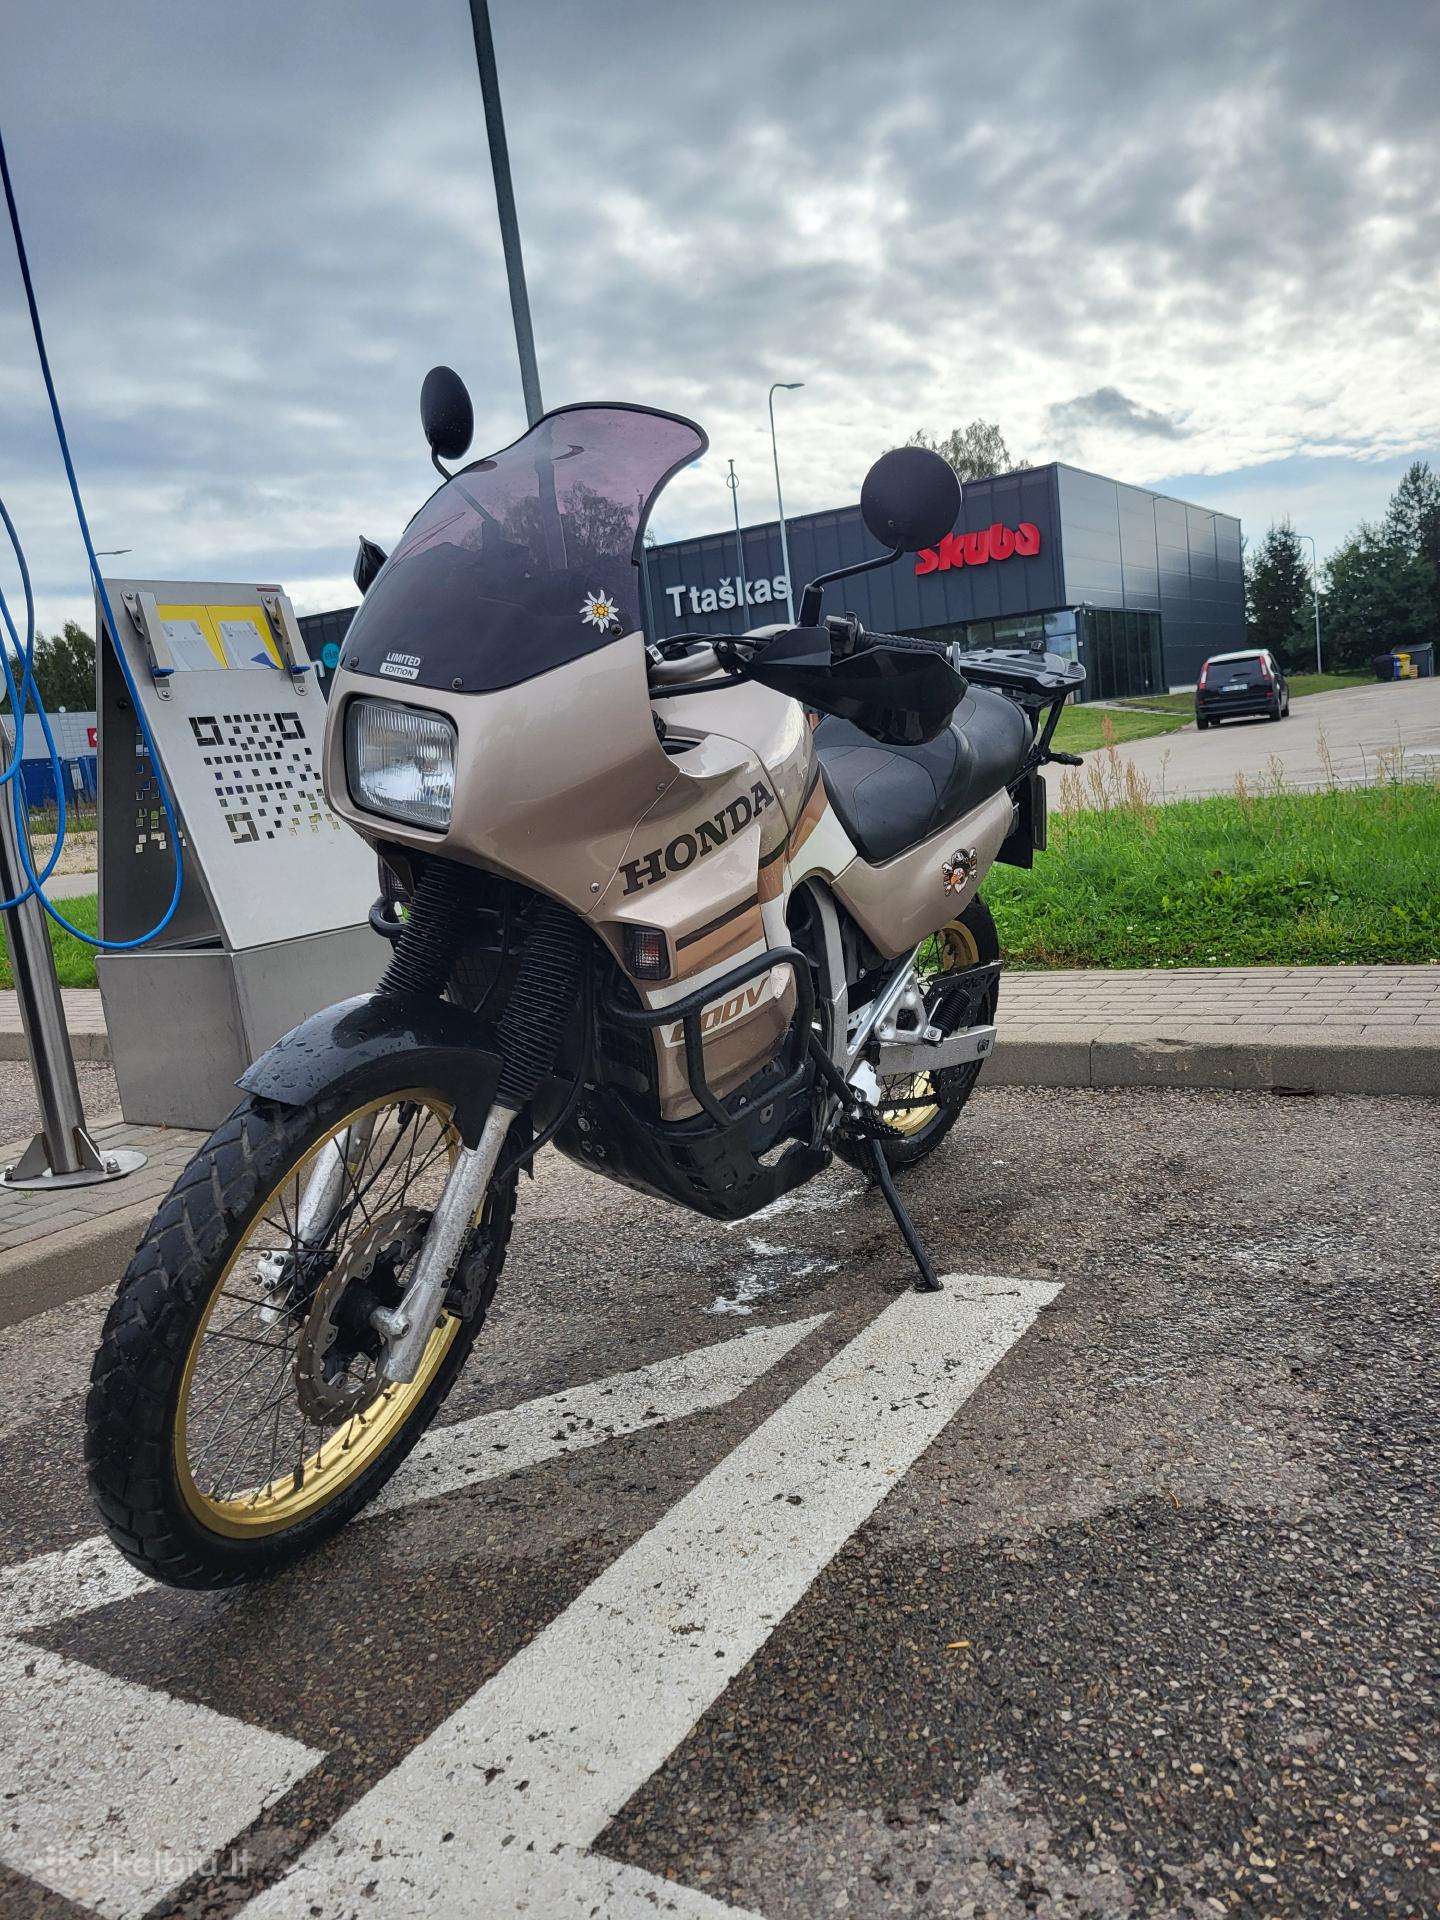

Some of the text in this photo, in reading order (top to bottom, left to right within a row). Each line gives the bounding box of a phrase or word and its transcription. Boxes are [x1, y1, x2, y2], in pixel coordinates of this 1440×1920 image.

[384, 665, 414, 677] EDITION
[386, 651, 421, 667] LIMITED
[619, 780, 774, 896] HONDA
[671, 975, 770, 1042] 00V
